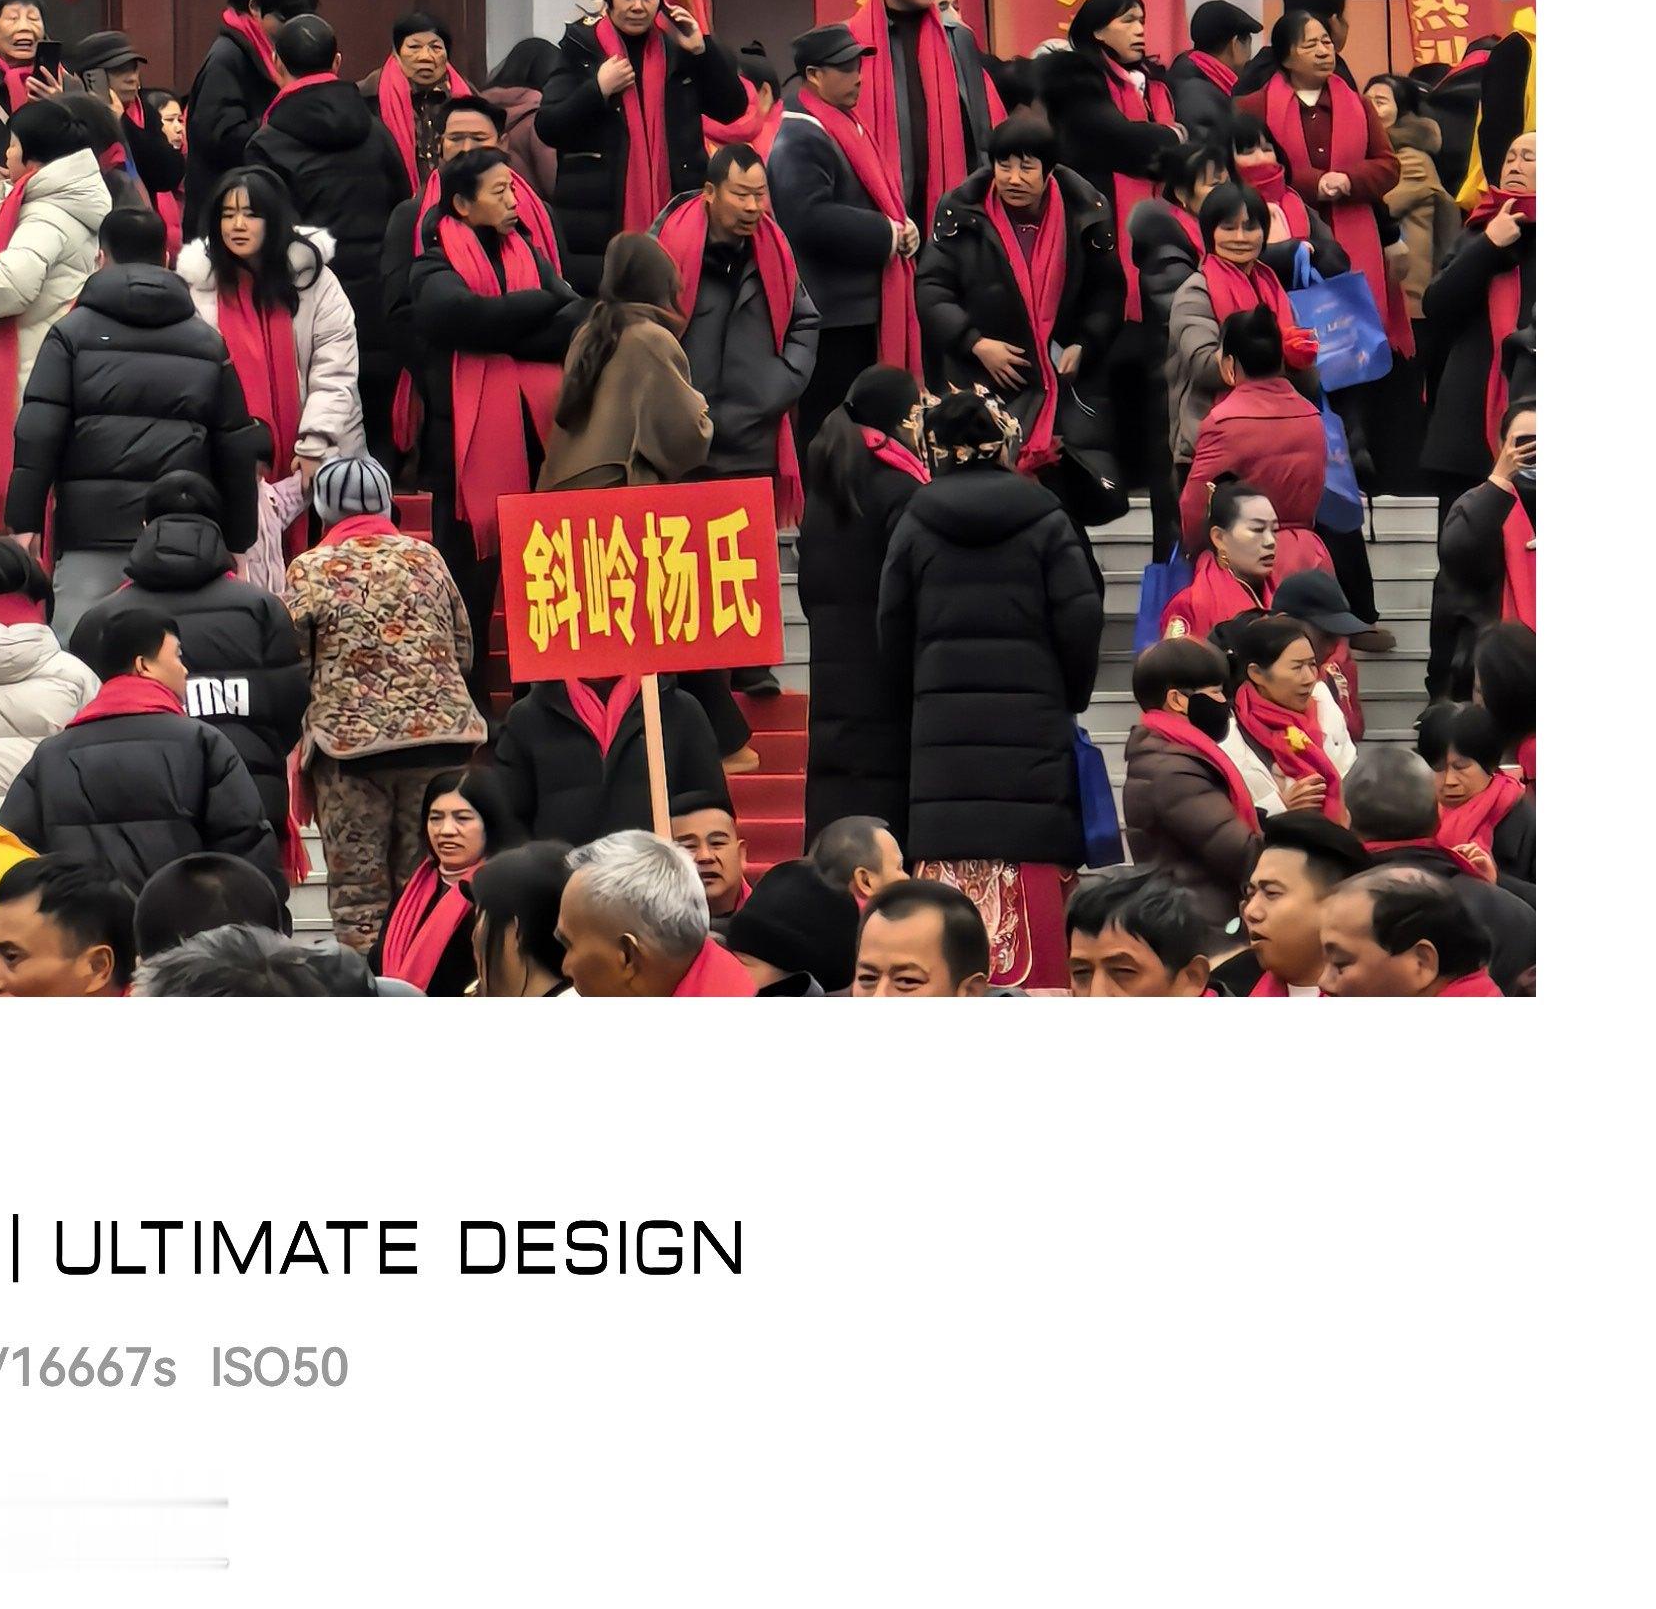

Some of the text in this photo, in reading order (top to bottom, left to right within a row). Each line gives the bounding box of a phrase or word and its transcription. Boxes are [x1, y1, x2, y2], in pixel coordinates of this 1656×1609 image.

[522, 507, 763, 654] 斜岭杨氏
[182, 677, 250, 717] MA
